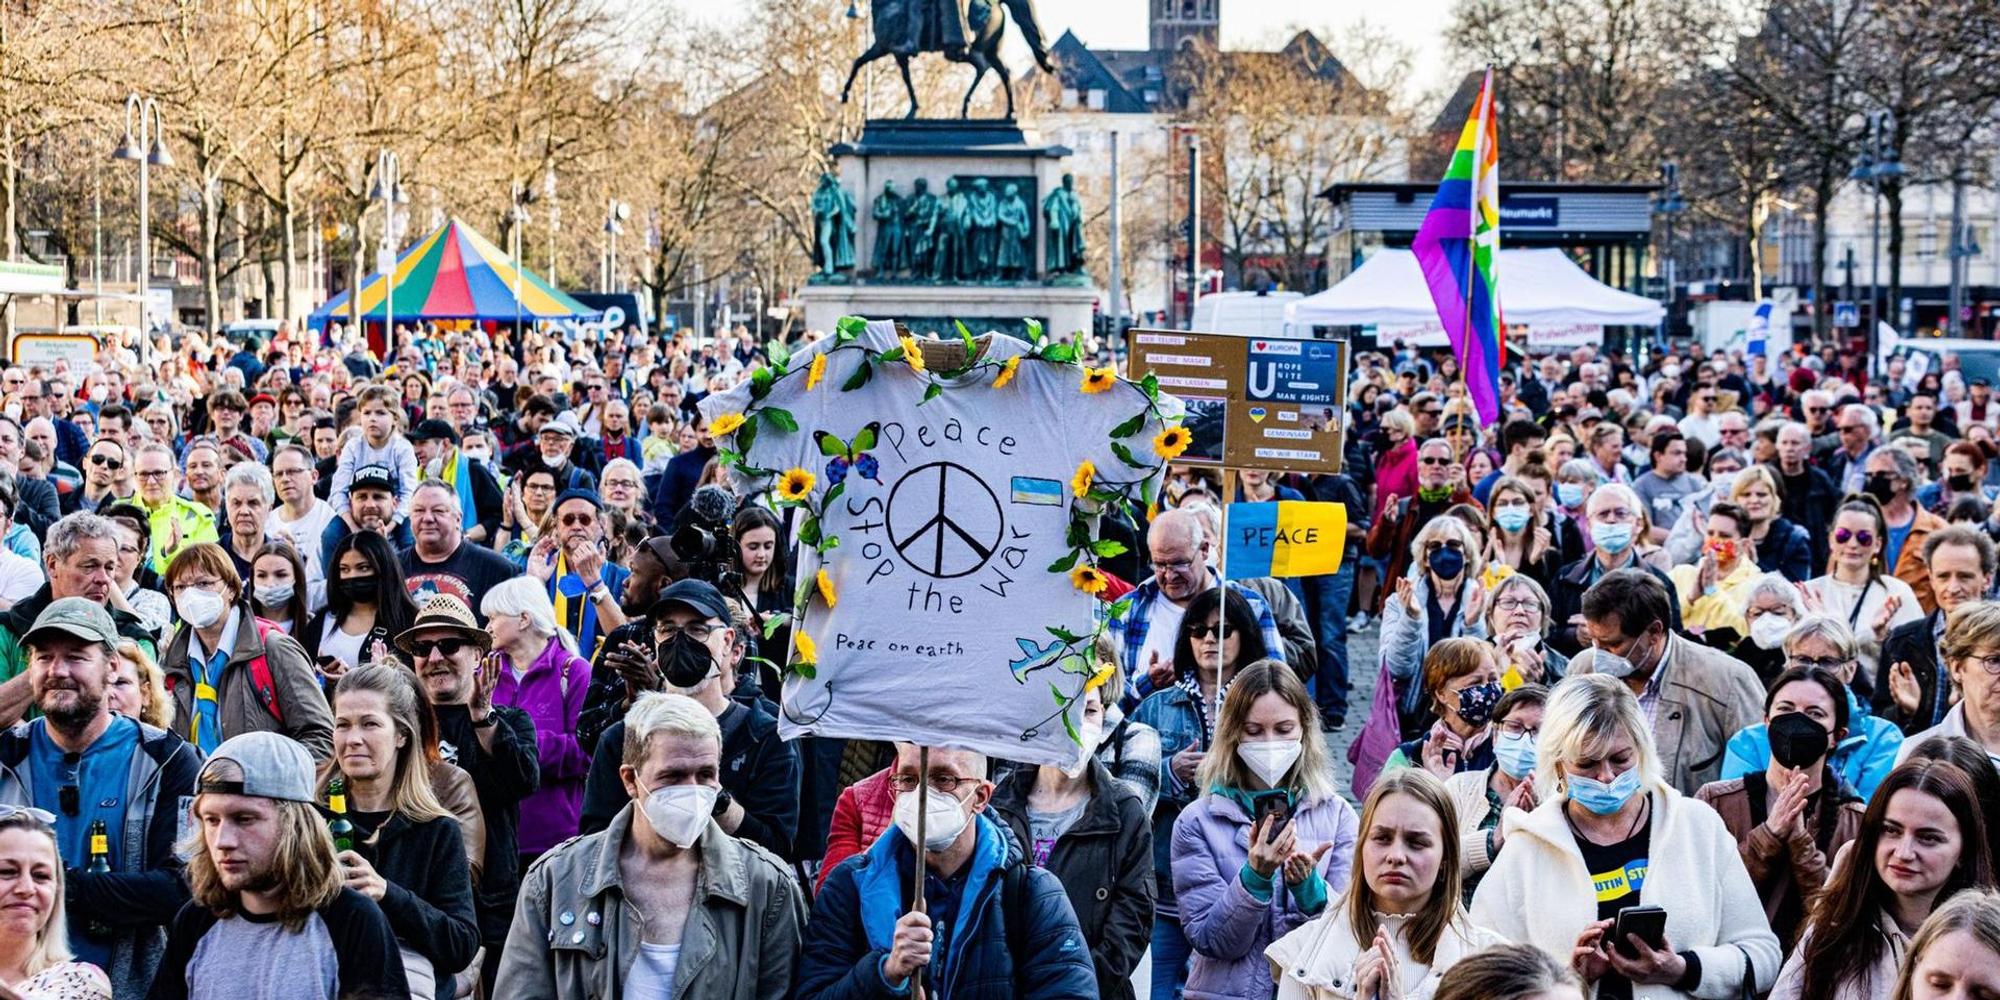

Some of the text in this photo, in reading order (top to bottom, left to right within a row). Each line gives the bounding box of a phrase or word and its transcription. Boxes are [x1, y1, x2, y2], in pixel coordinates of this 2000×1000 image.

[1300, 393, 1330, 402] RIGHTS
[883, 418, 1016, 463] Peace
[1242, 527, 1319, 547] PEACE
[847, 497, 895, 584] Stop
[908, 582, 963, 613] the
[888, 642, 909, 651] on
[916, 642, 963, 657] earth
[1594, 876, 1624, 892] UTIN
